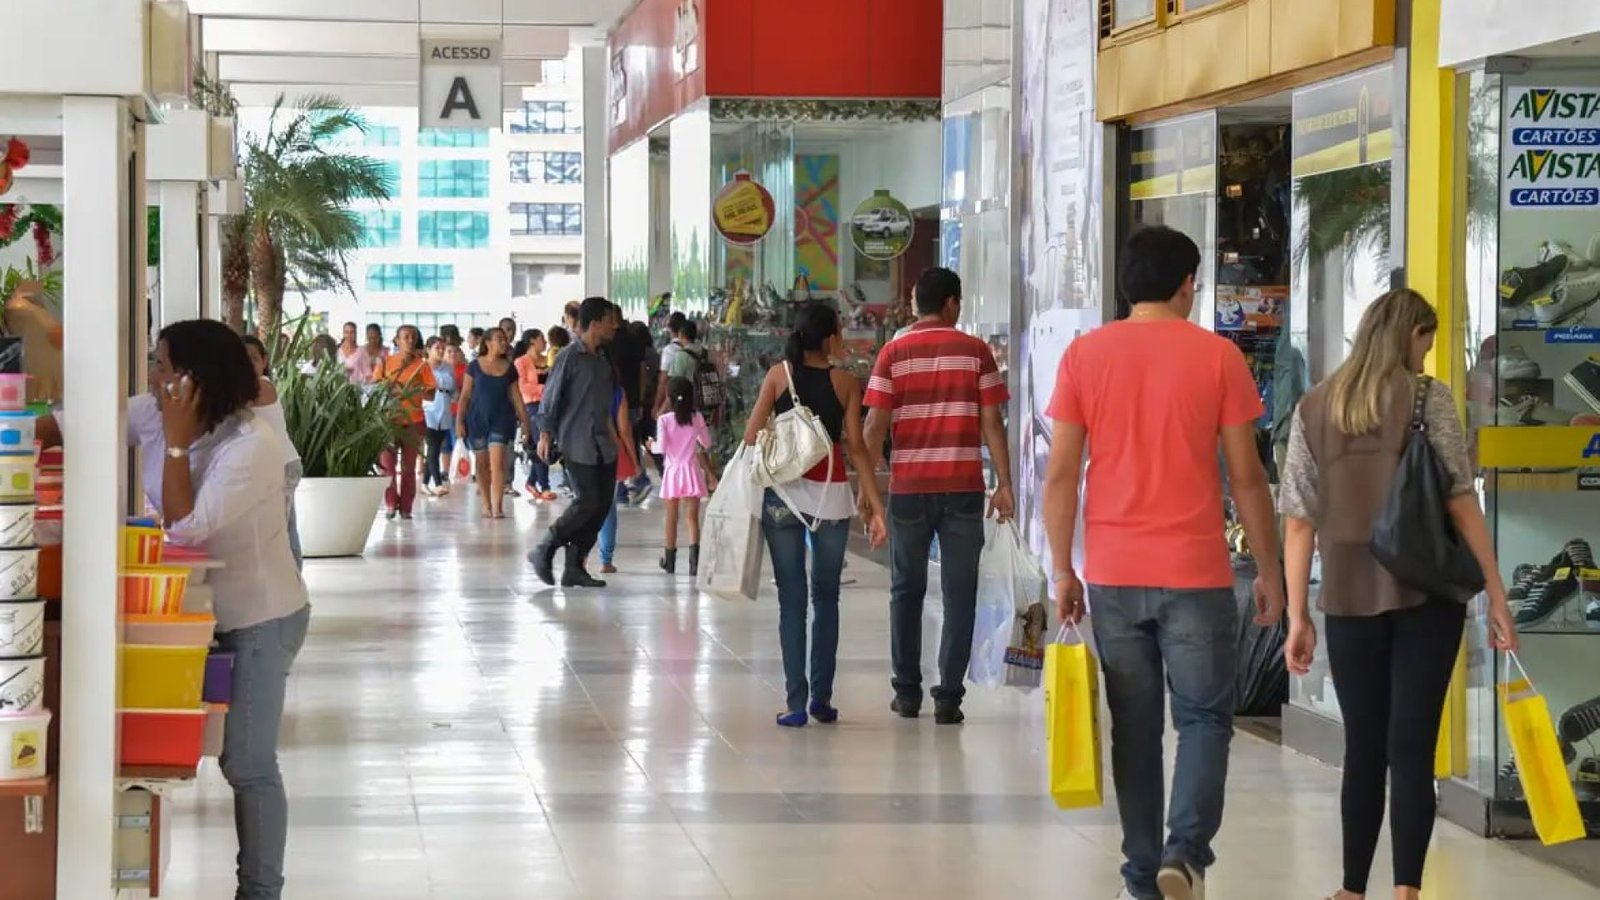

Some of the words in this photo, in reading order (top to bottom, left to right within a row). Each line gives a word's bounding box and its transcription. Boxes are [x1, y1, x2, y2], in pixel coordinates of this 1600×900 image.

[431, 46, 491, 59] ACESSO
[440, 76, 481, 119] A
[1510, 89, 1600, 122] AVISTA
[1518, 129, 1597, 143] CARTÕES
[1507, 149, 1600, 183] AVISTA
[1516, 188, 1594, 203] CARTÕES
